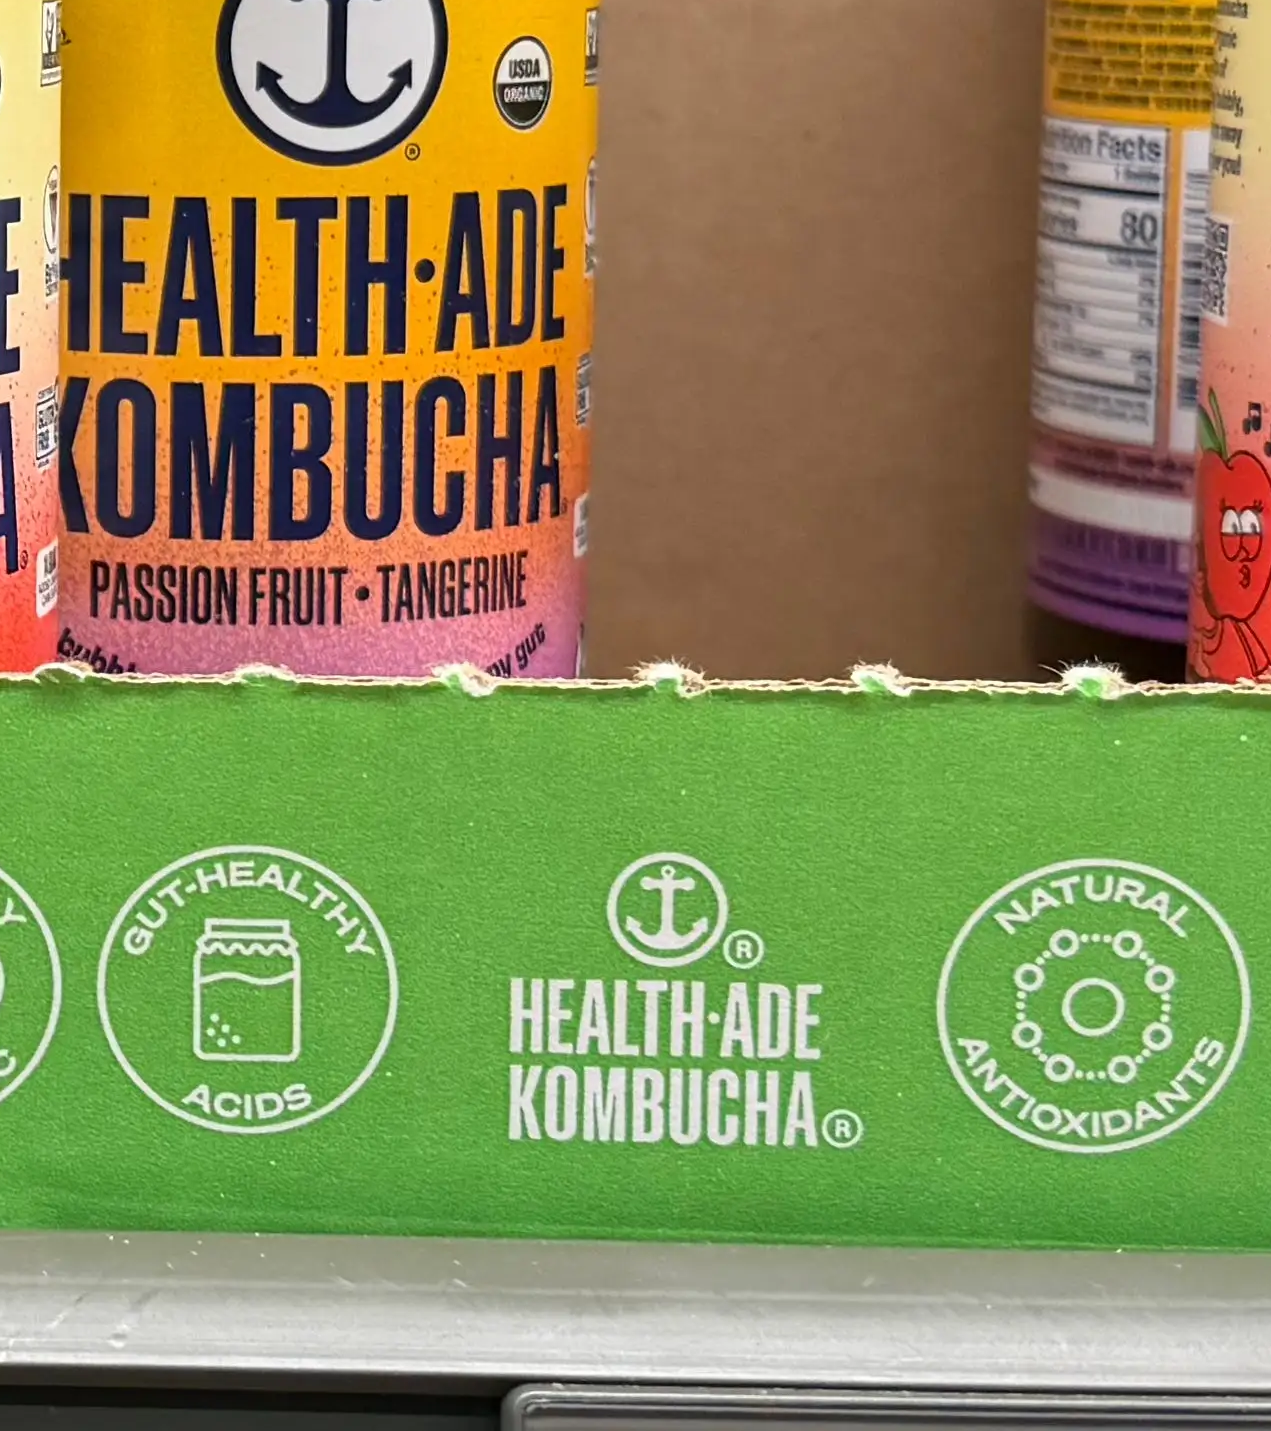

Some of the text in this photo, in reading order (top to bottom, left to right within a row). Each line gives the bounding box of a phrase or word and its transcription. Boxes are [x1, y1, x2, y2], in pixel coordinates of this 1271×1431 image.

[508, 58, 541, 80] USDA
[503, 85, 545, 103] ORGANIC
[1097, 129, 1161, 162] Facts
[1120, 207, 1158, 246] 80
[89, 559, 237, 626] PASSION
[248, 565, 348, 626] FRUIT
[376, 549, 529, 624] TANGERINE
[514, 621, 546, 671] gut
[123, 860, 376, 955] GUT-HEALTHY
[992, 874, 1189, 938] NATURAL
[181, 1083, 312, 1120] ACIDS
[957, 1036, 1225, 1139] ANTIOXIDANTS
